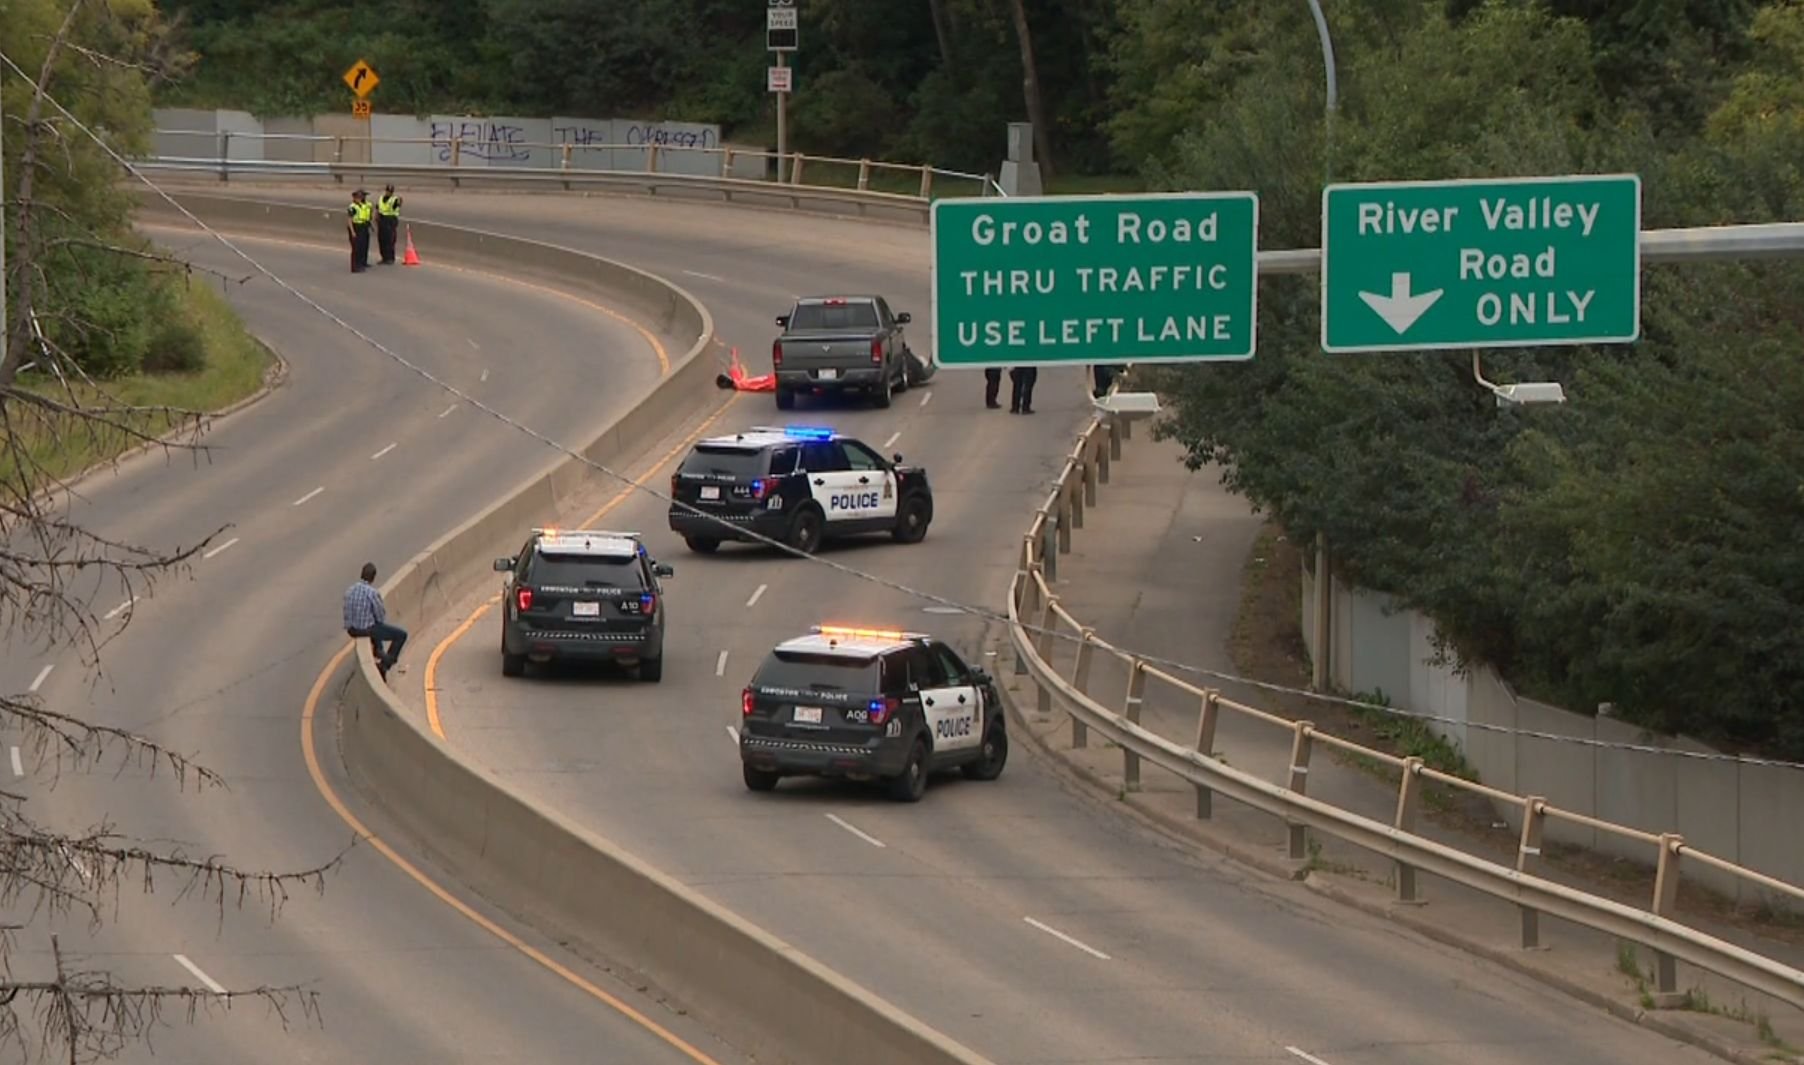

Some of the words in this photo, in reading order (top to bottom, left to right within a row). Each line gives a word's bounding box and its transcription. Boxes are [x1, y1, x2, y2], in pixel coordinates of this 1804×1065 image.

[432, 122, 525, 153] ELEVATE
[555, 127, 602, 152] THE
[972, 214, 1089, 245] Groat
[1118, 213, 1217, 243] Road
[1359, 202, 1458, 234] River
[1480, 198, 1599, 235] Valley
[1460, 246, 1555, 279] Road
[961, 270, 1055, 295] THRU
[1077, 265, 1226, 292] TRAFFIC
[1477, 291, 1594, 325] ONLY
[959, 321, 1025, 346] USE
[1039, 319, 1124, 344] LEFT
[1138, 316, 1230, 341] LANE
[830, 492, 879, 511] POLICE
[596, 587, 622, 596] POLICE
[820, 691, 849, 702] POLICE
[936, 716, 971, 739] POLICE
